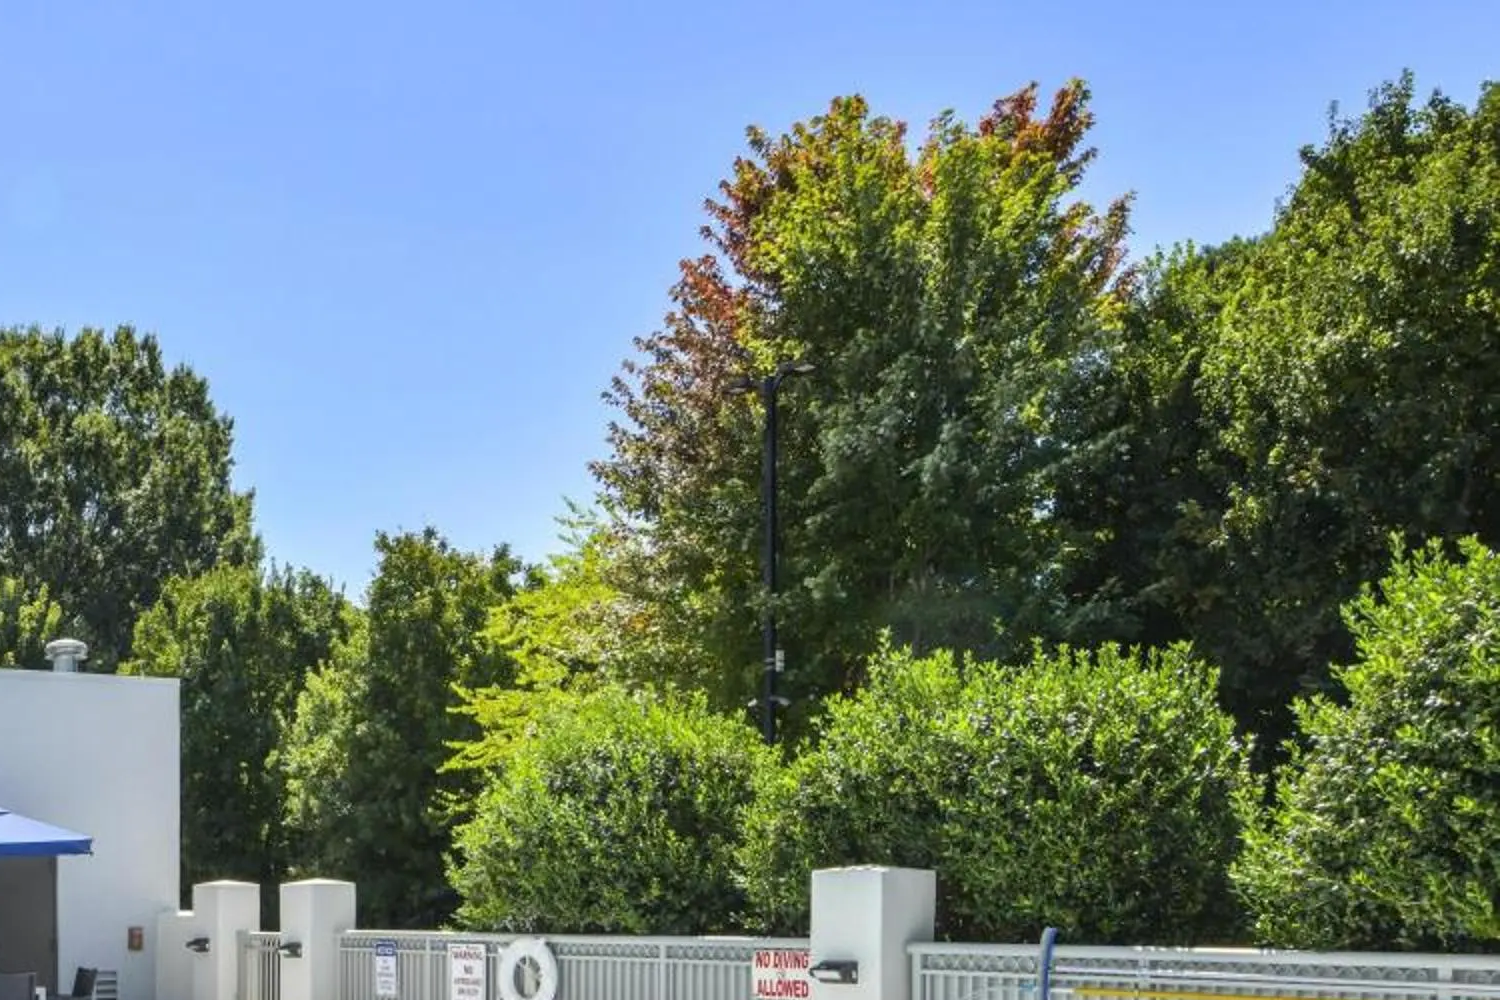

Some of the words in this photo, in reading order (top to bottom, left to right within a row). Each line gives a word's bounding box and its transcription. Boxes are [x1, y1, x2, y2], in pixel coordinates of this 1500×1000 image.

[755, 951, 771, 969] NO
[773, 951, 809, 970] DIVING
[757, 979, 809, 998] ALLOWED
